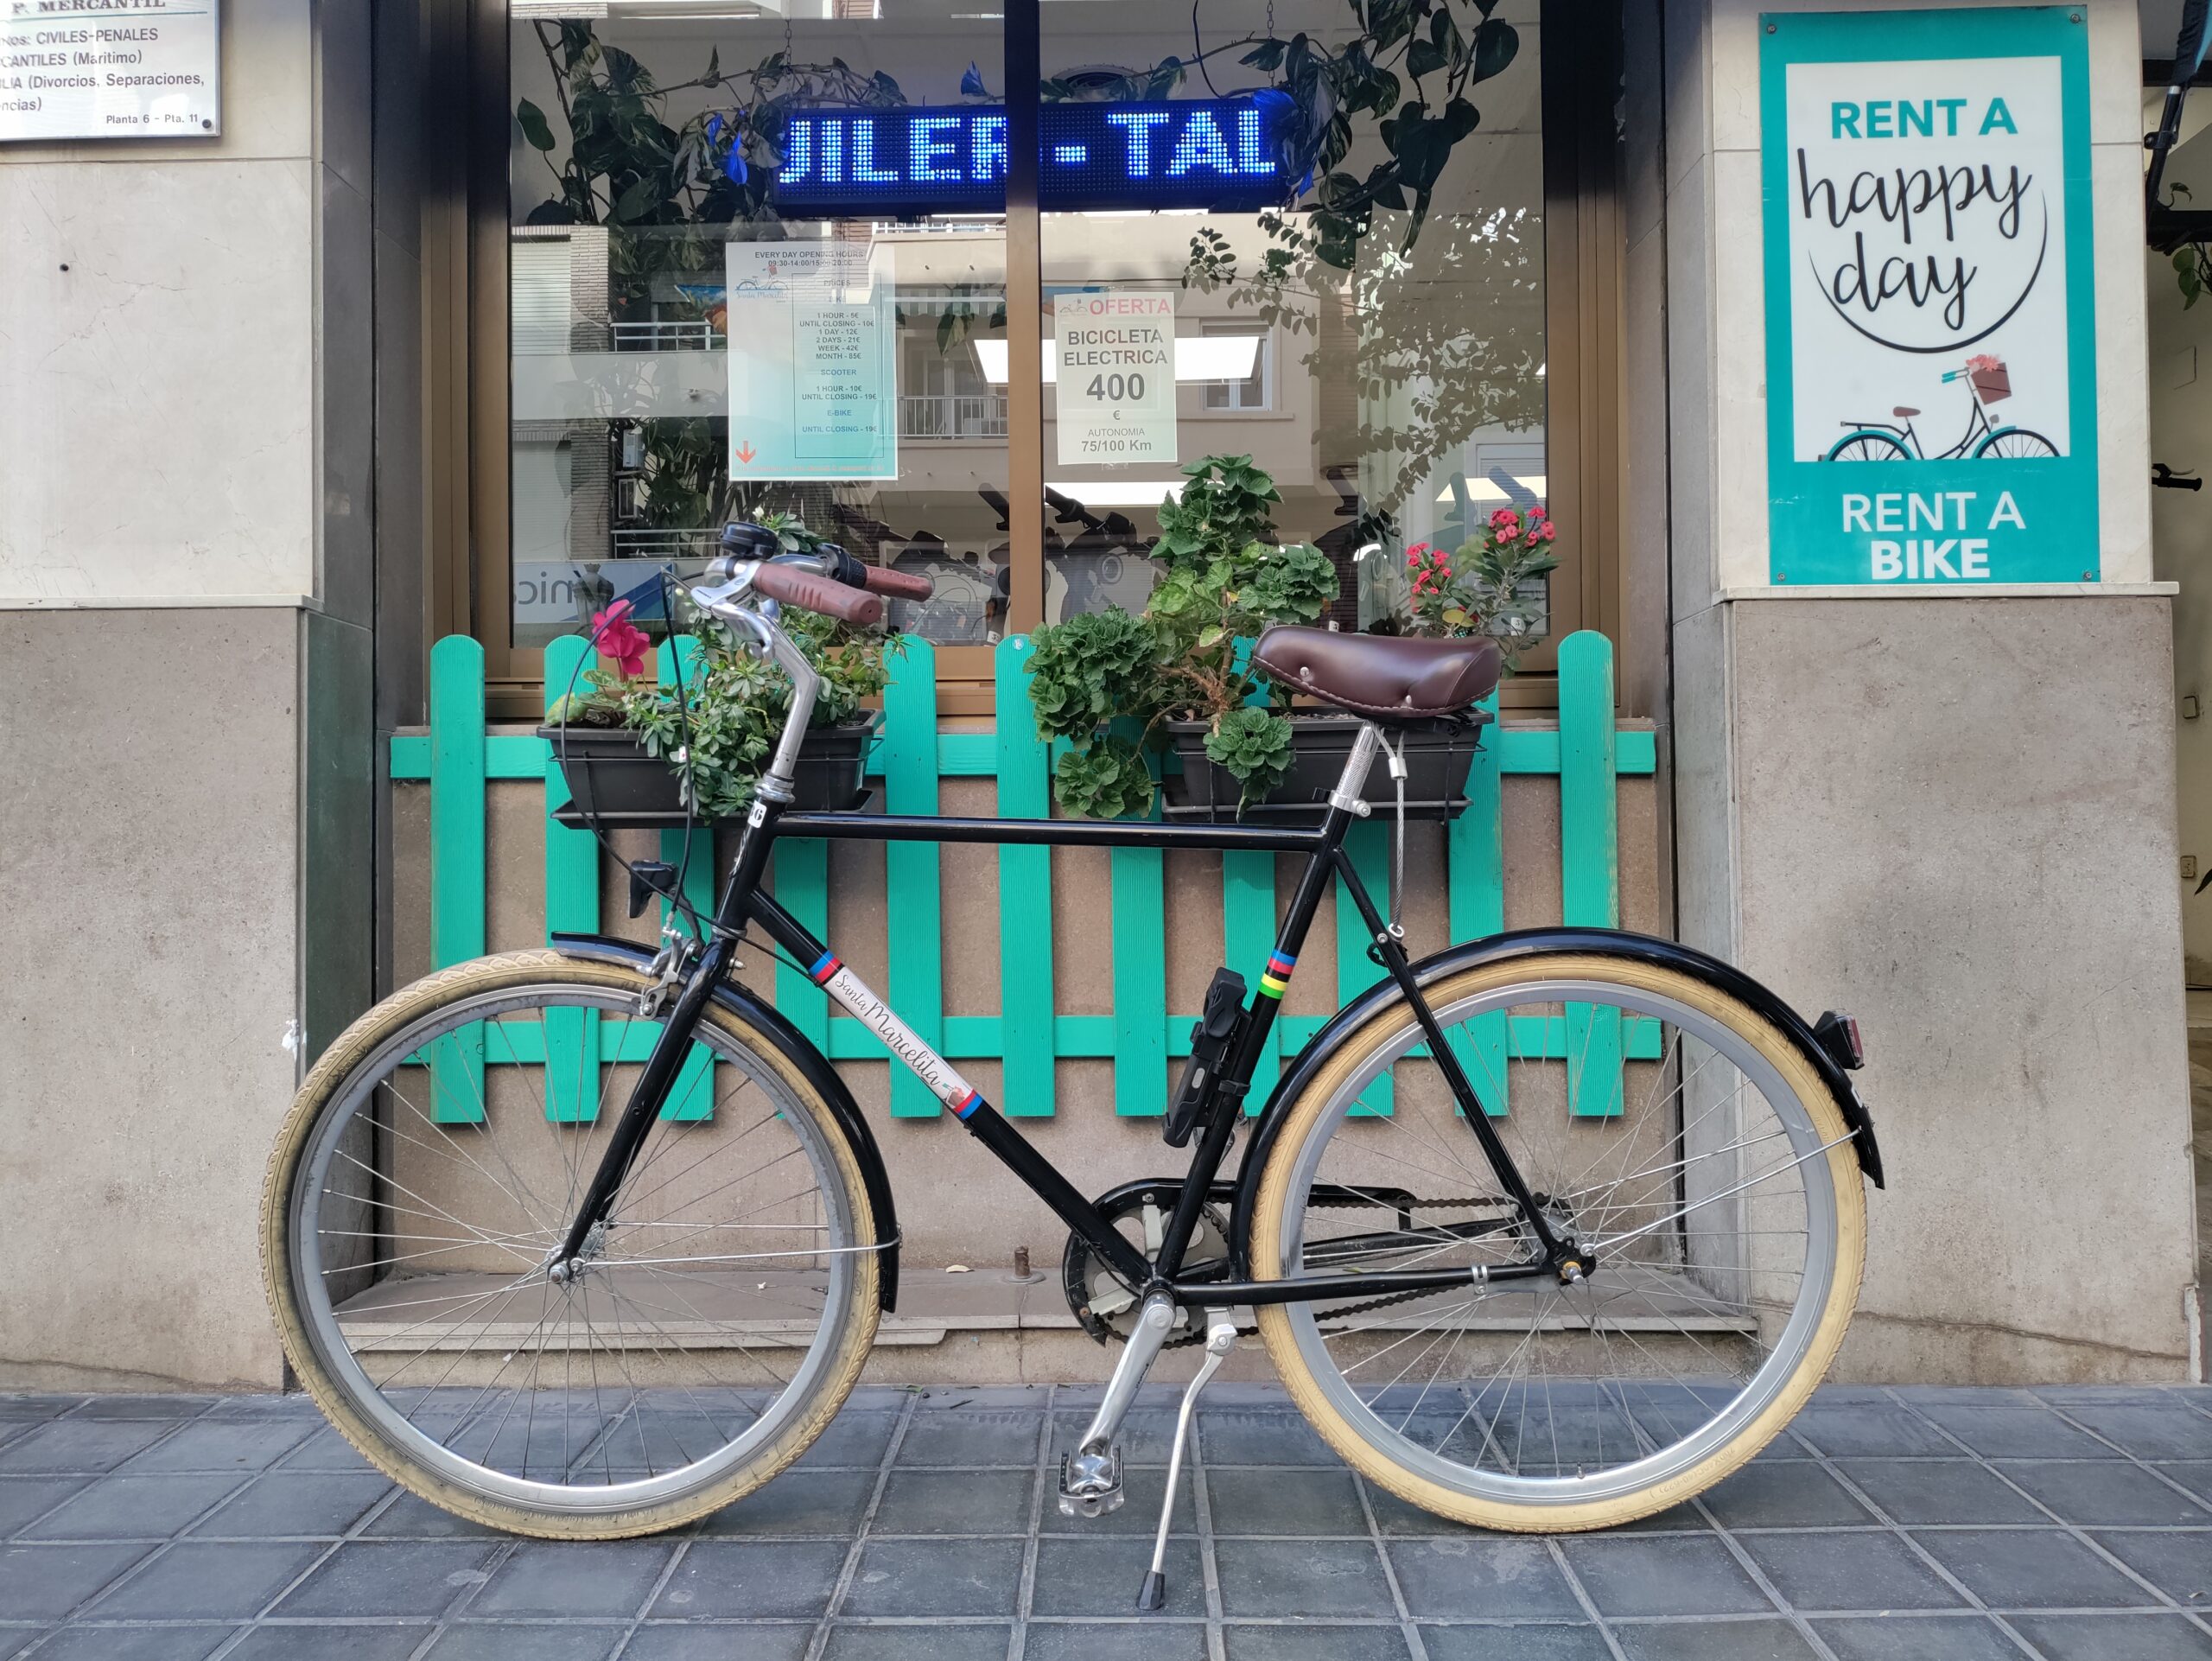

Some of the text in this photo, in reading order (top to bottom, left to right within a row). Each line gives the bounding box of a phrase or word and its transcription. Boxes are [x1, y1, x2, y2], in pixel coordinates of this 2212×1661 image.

[36, 28, 158, 44] CIVILES-PENALES
[29, 74, 100, 90] (Divorcios,
[106, 72, 205, 87] Separaciones,
[106, 115, 137, 124] Planta
[143, 114, 149, 124] 6
[164, 114, 184, 124] Pta.
[189, 114, 198, 123] 11
[1831, 98, 2018, 139] RENT A
[1797, 148, 2032, 244] happy
[1833, 231, 1977, 331] day
[1090, 298, 1172, 315] OFERTA
[1068, 328, 1164, 345] BICICLETA
[1064, 349, 1168, 366] ELECTRICA
[1086, 372, 1145, 401] 400
[1112, 410, 1121, 420] €
[1088, 428, 1145, 436] AUTONOMIA
[1081, 439, 1152, 452] 75/100 Km
[1842, 491, 2026, 532] RENT A
[1870, 538, 1991, 581] BIKE
[835, 974, 941, 1086] Santa Marcelita
